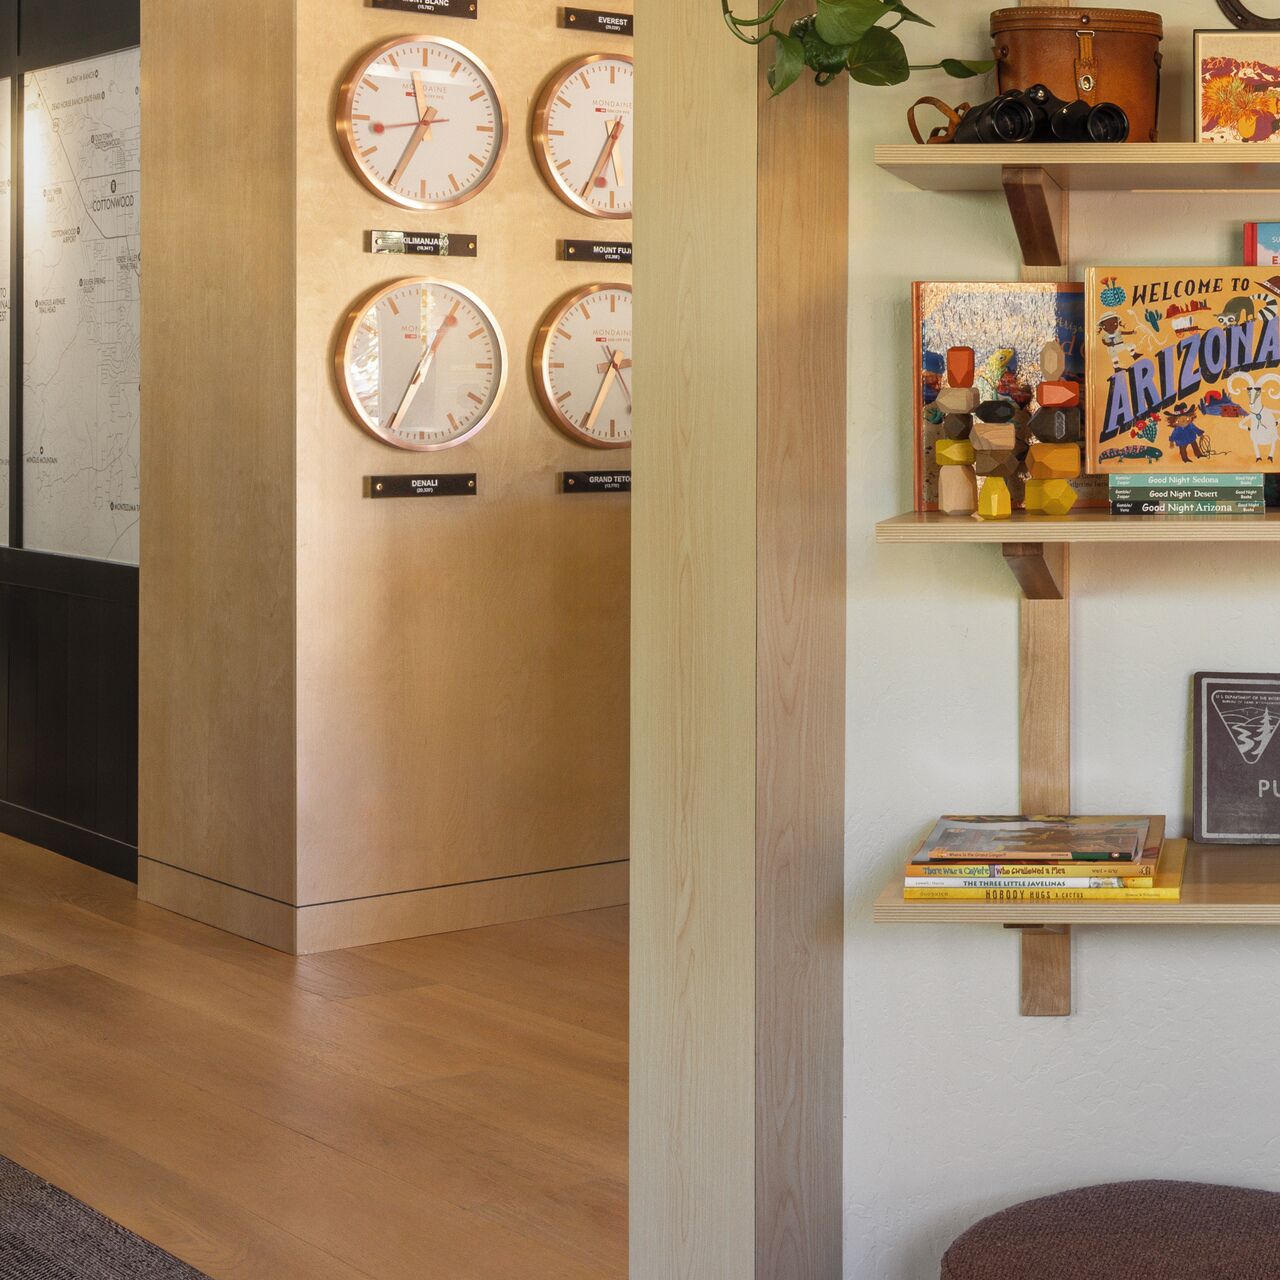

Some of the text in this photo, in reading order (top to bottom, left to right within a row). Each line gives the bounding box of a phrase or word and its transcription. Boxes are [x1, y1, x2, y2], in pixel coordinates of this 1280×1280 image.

[598, 16, 628, 26] EVEREST
[93, 195, 134, 212] COTTONWOOD
[593, 246, 617, 254] MOUNT
[1132, 278, 1249, 306] WELCOME TO
[1169, 476, 1190, 485] Night
[1193, 476, 1218, 484] Sedona
[1170, 490, 1191, 498] Night
[1142, 503, 1232, 513] Good Night Arizona
[986, 890, 1024, 899] NOBODY
[1030, 891, 1050, 899] HUGS
